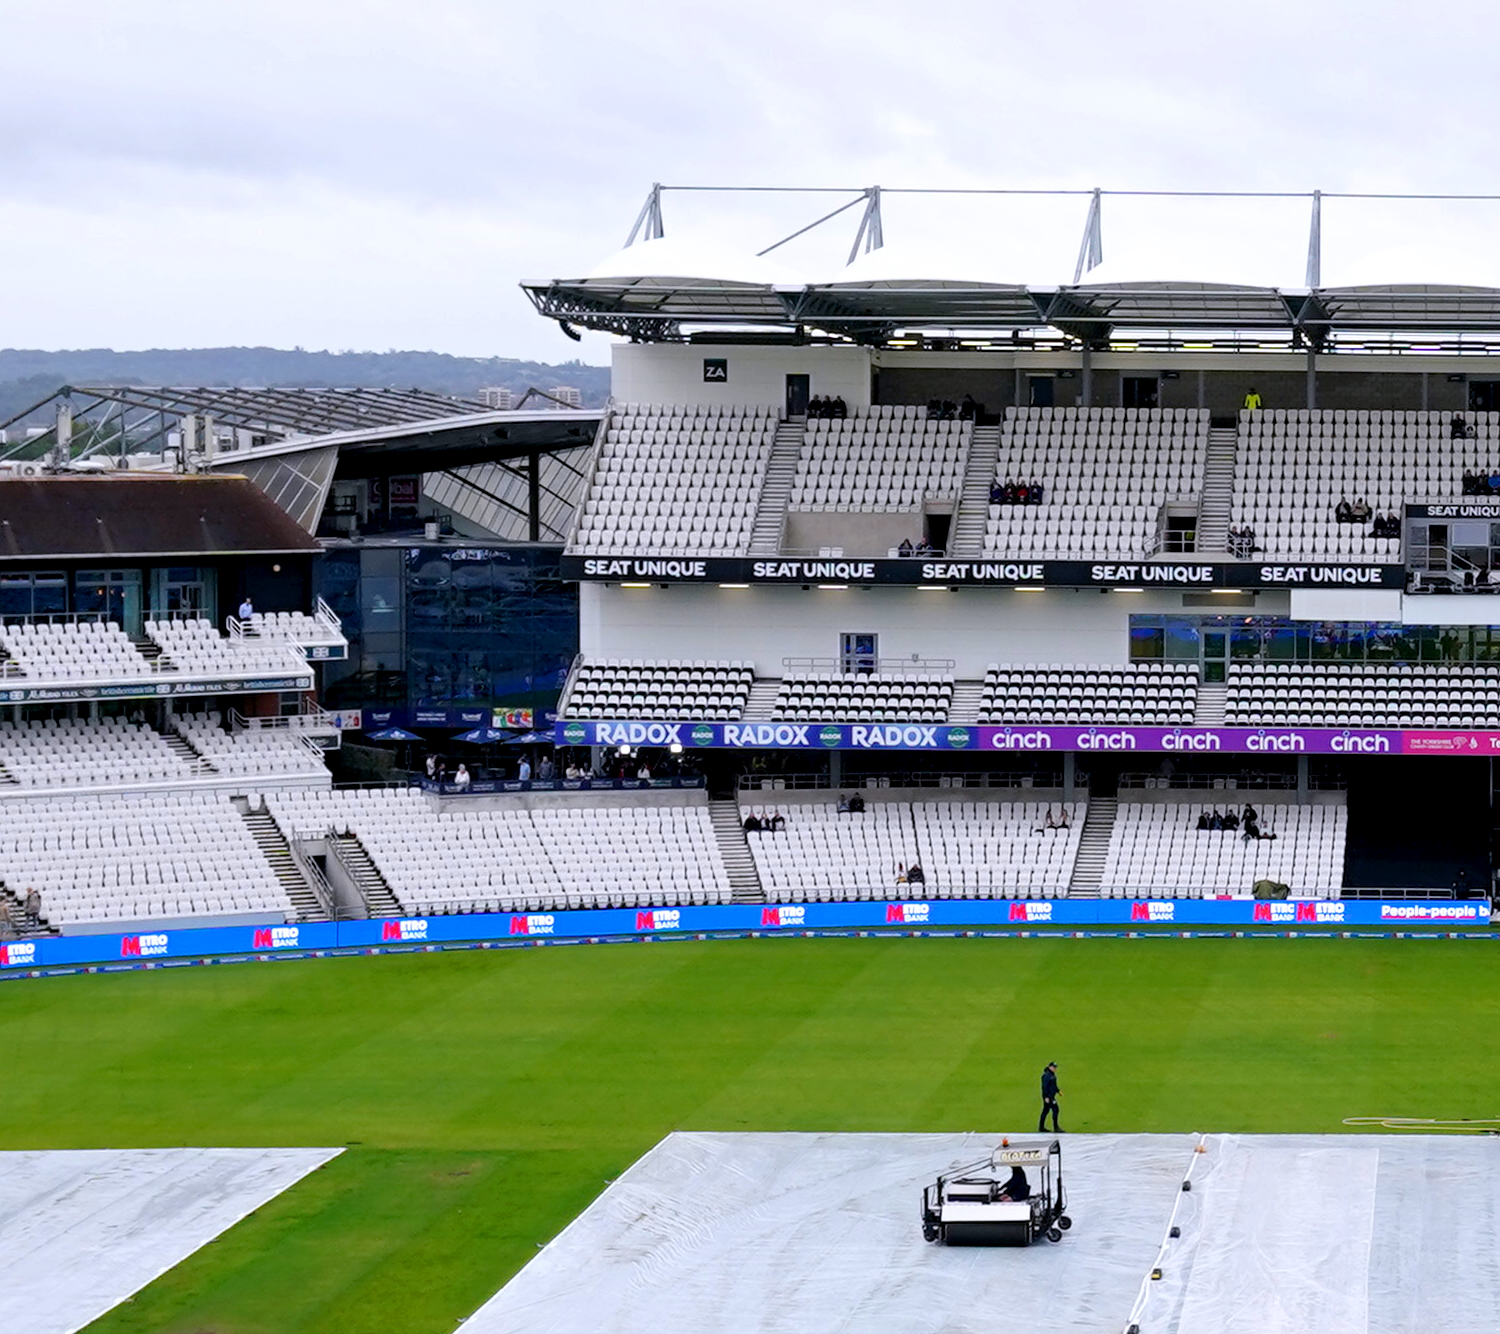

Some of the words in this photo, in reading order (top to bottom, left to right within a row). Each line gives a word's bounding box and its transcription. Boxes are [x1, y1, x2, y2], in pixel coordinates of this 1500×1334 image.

[585, 560, 631, 575] SEAT
[635, 560, 705, 577] UNIQUE
[923, 564, 969, 578] SEAT
[973, 564, 1043, 580] UNIQUE
[1261, 567, 1307, 581] SEAT
[1311, 567, 1381, 583] UNIQUE
[596, 724, 681, 744] RADOX
[724, 725, 809, 745] RADOX
[852, 726, 936, 747] RADOX
[992, 727, 1050, 750] cinch
[1161, 727, 1219, 750] cinch
[1331, 727, 1389, 750] cinch
[887, 904, 929, 921] METRO
[904, 914, 928, 922] BANK
[1298, 903, 1344, 920] METRO
[1317, 914, 1344, 922] BANK
[1382, 904, 1476, 919] People-people
[511, 915, 554, 933] METRO
[529, 926, 553, 934] BANK
[122, 935, 168, 955] METRO
[141, 946, 167, 955] BANK
